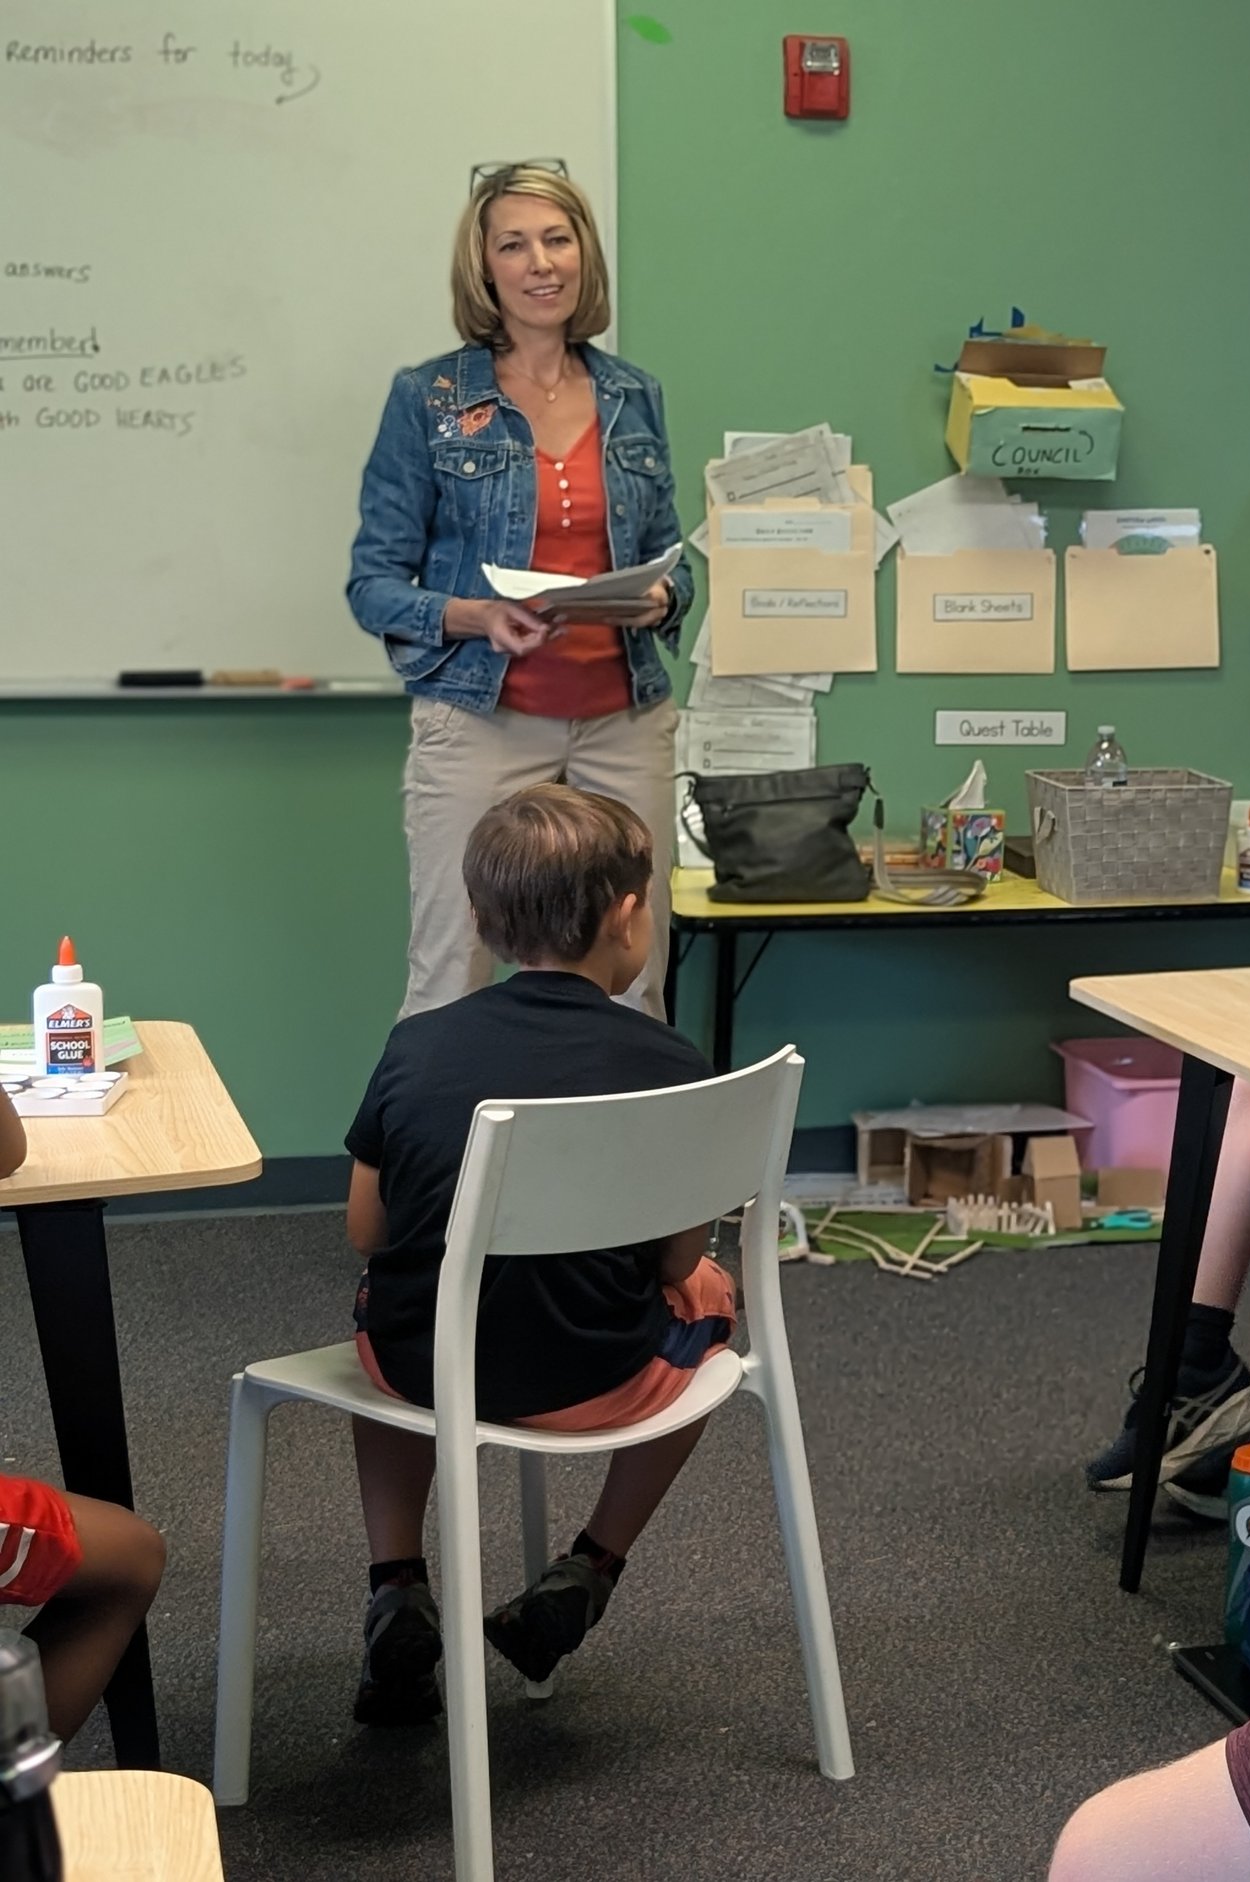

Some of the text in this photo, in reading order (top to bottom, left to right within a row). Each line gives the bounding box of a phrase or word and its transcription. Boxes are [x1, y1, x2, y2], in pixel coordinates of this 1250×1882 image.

[6, 33, 299, 86] Reminders for today
[5, 262, 91, 283] answers
[22, 374, 54, 392] are
[74, 371, 130, 393] GOOD
[139, 354, 248, 387] EAGLES
[35, 407, 101, 428] GOOD
[992, 445, 1082, 467] COUNCIL
[960, 720, 1054, 737] Quest Table
[48, 1019, 91, 1028] ELMER'S
[50, 1041, 91, 1050] SCHOOL
[57, 1050, 84, 1060] GLUE
